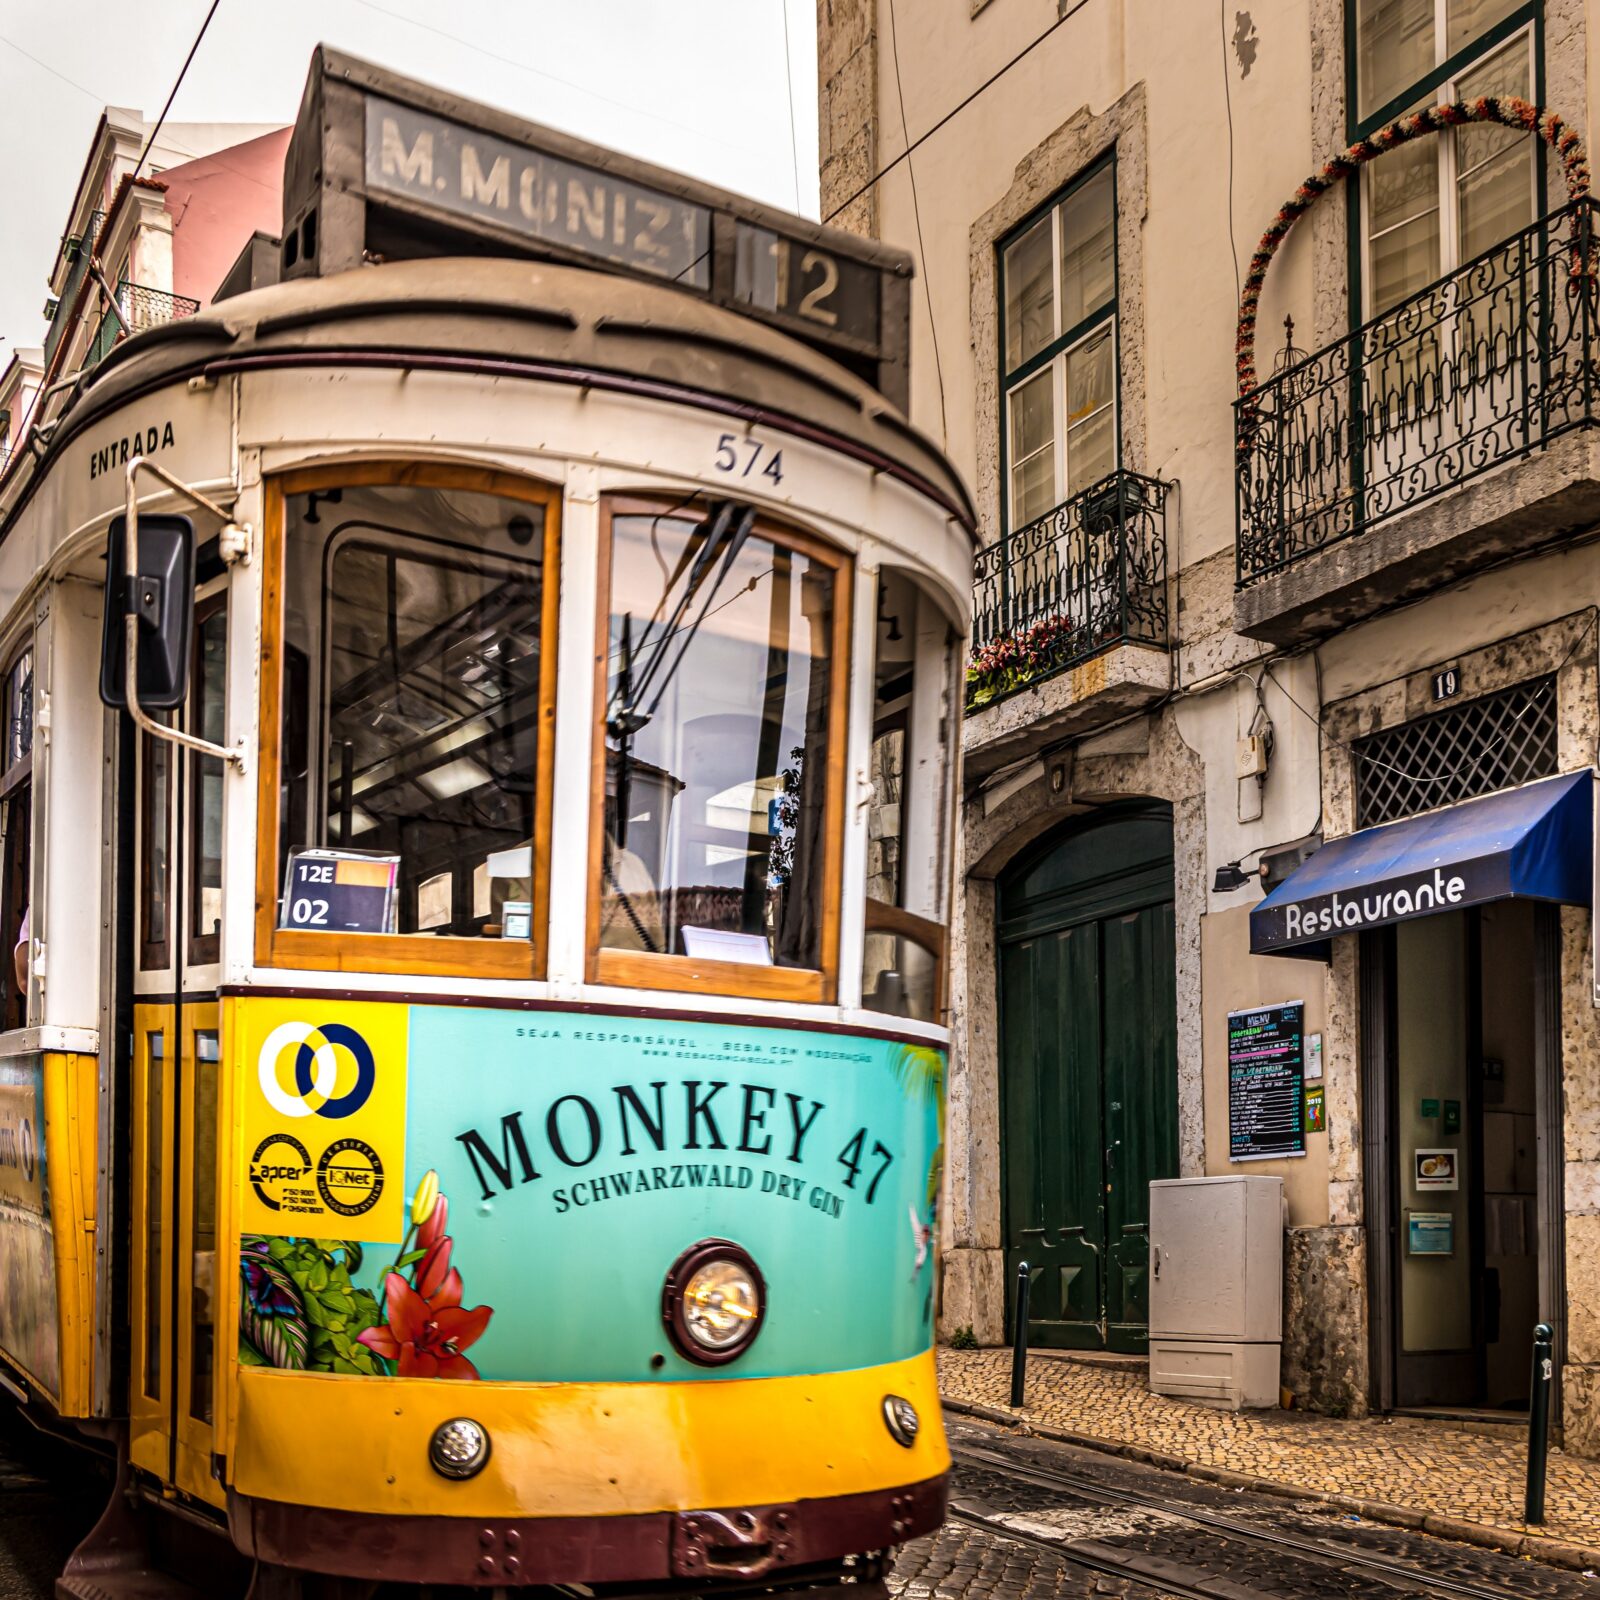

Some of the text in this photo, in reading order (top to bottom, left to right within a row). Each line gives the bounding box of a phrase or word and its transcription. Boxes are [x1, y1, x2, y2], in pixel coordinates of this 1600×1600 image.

[769, 239, 840, 327] 12
[90, 421, 175, 481] ENTRADA
[714, 433, 784, 487] 574
[1437, 671, 1456, 699] 19
[299, 865, 334, 884] 12E
[292, 898, 330, 925] 02
[1286, 868, 1466, 940] Restaurante
[516, 1028, 561, 1039] SEJA
[455, 1081, 893, 1205] MONKEY 47
[261, 1165, 302, 1183] apcer
[552, 1164, 845, 1219] SCHWARZWALD DRY GIN
